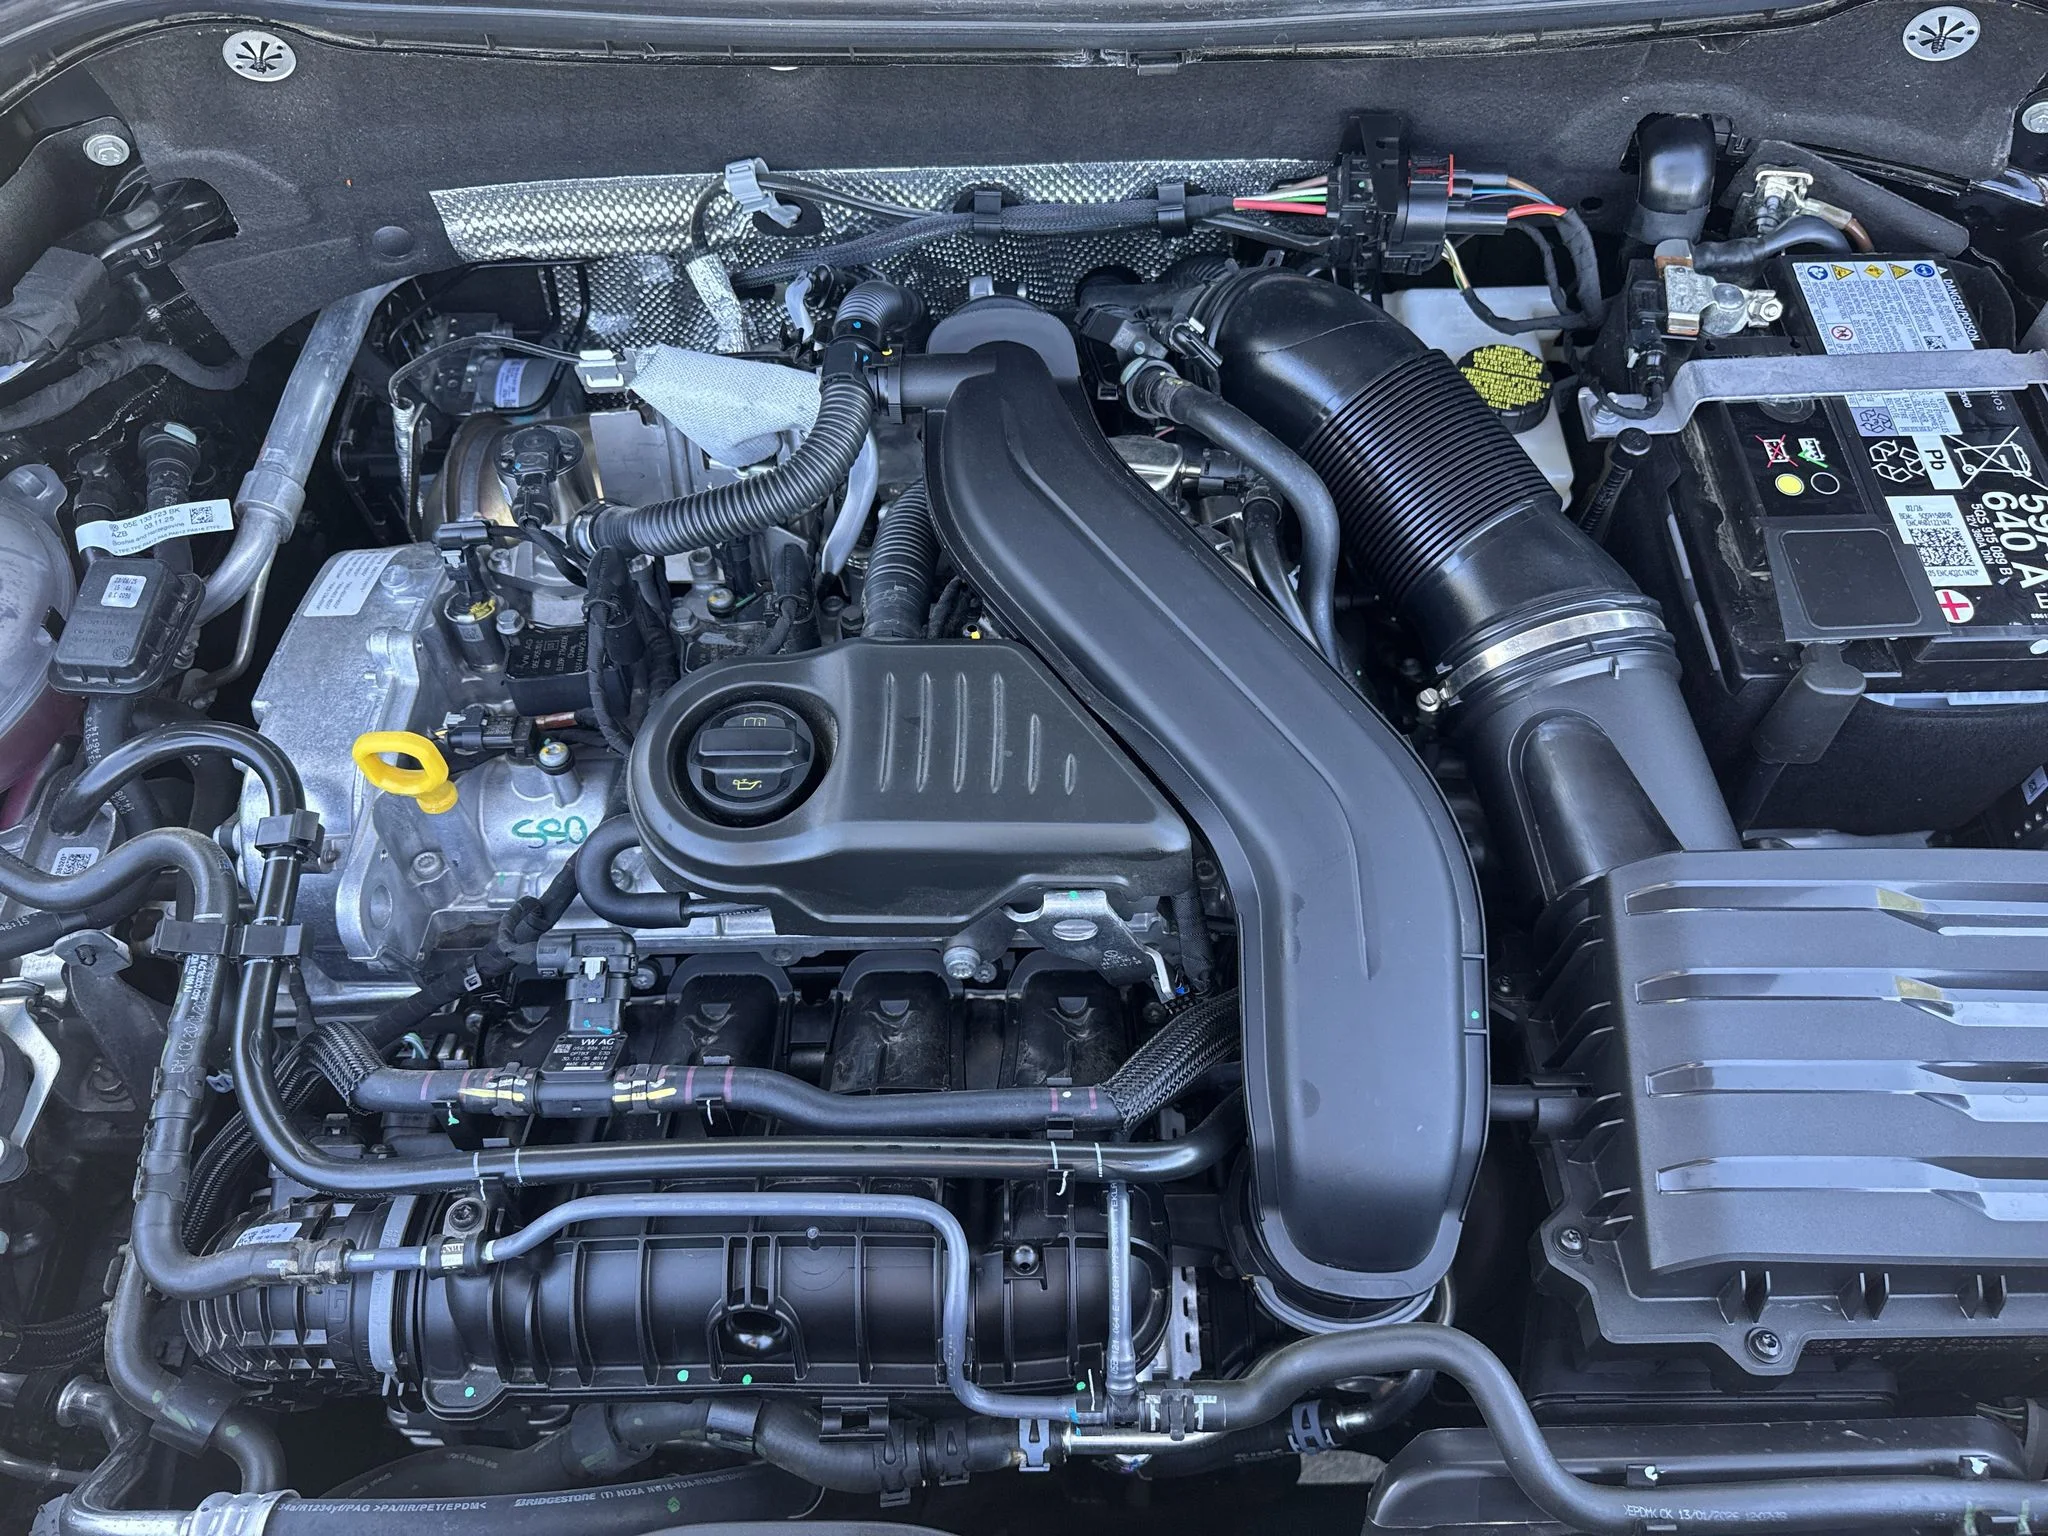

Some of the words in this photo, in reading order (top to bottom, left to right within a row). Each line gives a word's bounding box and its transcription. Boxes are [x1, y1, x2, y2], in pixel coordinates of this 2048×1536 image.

[1942, 279, 1980, 341] DANGER/POISON
[1925, 450, 1947, 470] Pb
[140, 516, 152, 525] 133
[153, 511, 167, 519] 723
[1971, 504, 1990, 524] 5QS
[1966, 515, 1978, 527] 12V
[1972, 529, 1986, 547] 380A
[1980, 550, 1995, 564] DIN
[1982, 527, 1999, 544] 915
[1982, 491, 2037, 552] 640
[2011, 562, 2048, 588] A
[1990, 546, 2008, 564] 089
[514, 1493, 595, 1506] BRIDGESTONE
